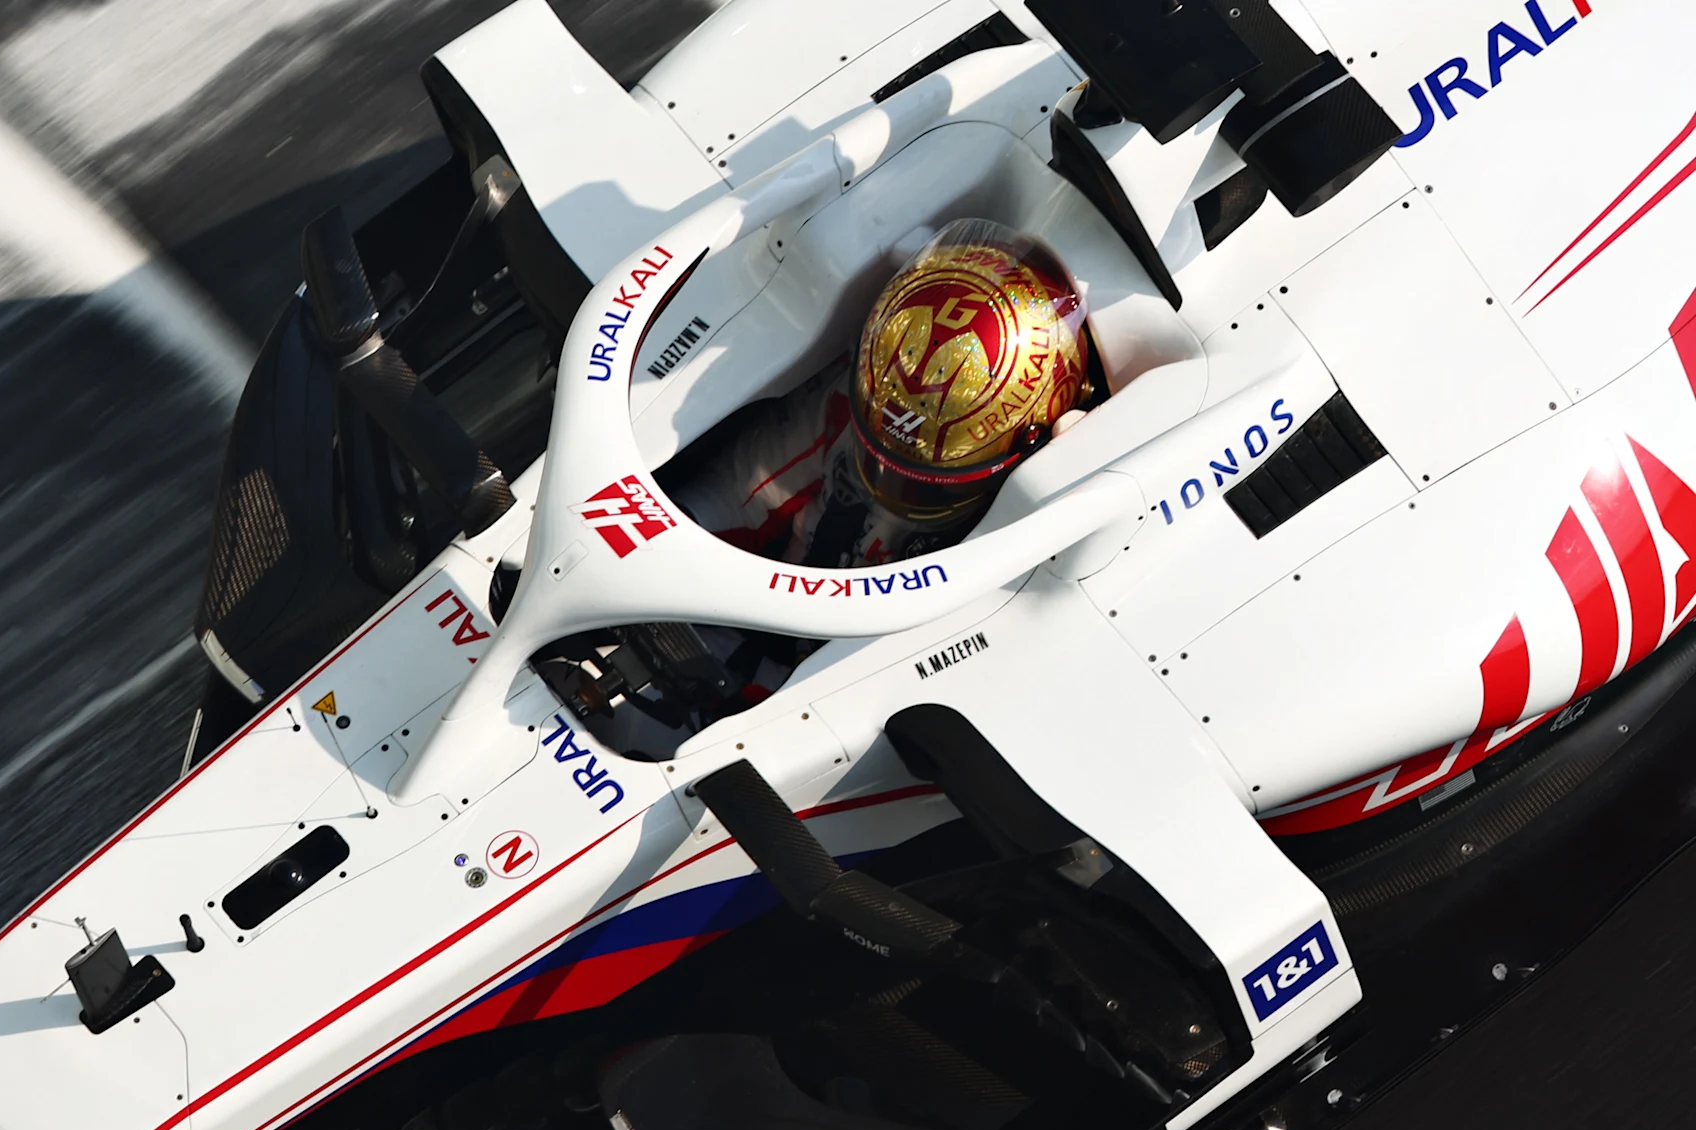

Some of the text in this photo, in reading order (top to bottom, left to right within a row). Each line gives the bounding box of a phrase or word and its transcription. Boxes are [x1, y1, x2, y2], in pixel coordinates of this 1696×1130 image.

[1393, 0, 1593, 148] URAL
[587, 245, 674, 382] URALKALI
[647, 316, 711, 380] N.MAZEPIN
[967, 327, 1050, 442] URALKALI
[1159, 398, 1294, 524] IONOS
[769, 564, 948, 597] URALKALI
[915, 632, 989, 680] N.MAZEPIN
[491, 835, 534, 874] N
[1252, 937, 1325, 1002] 1&1
